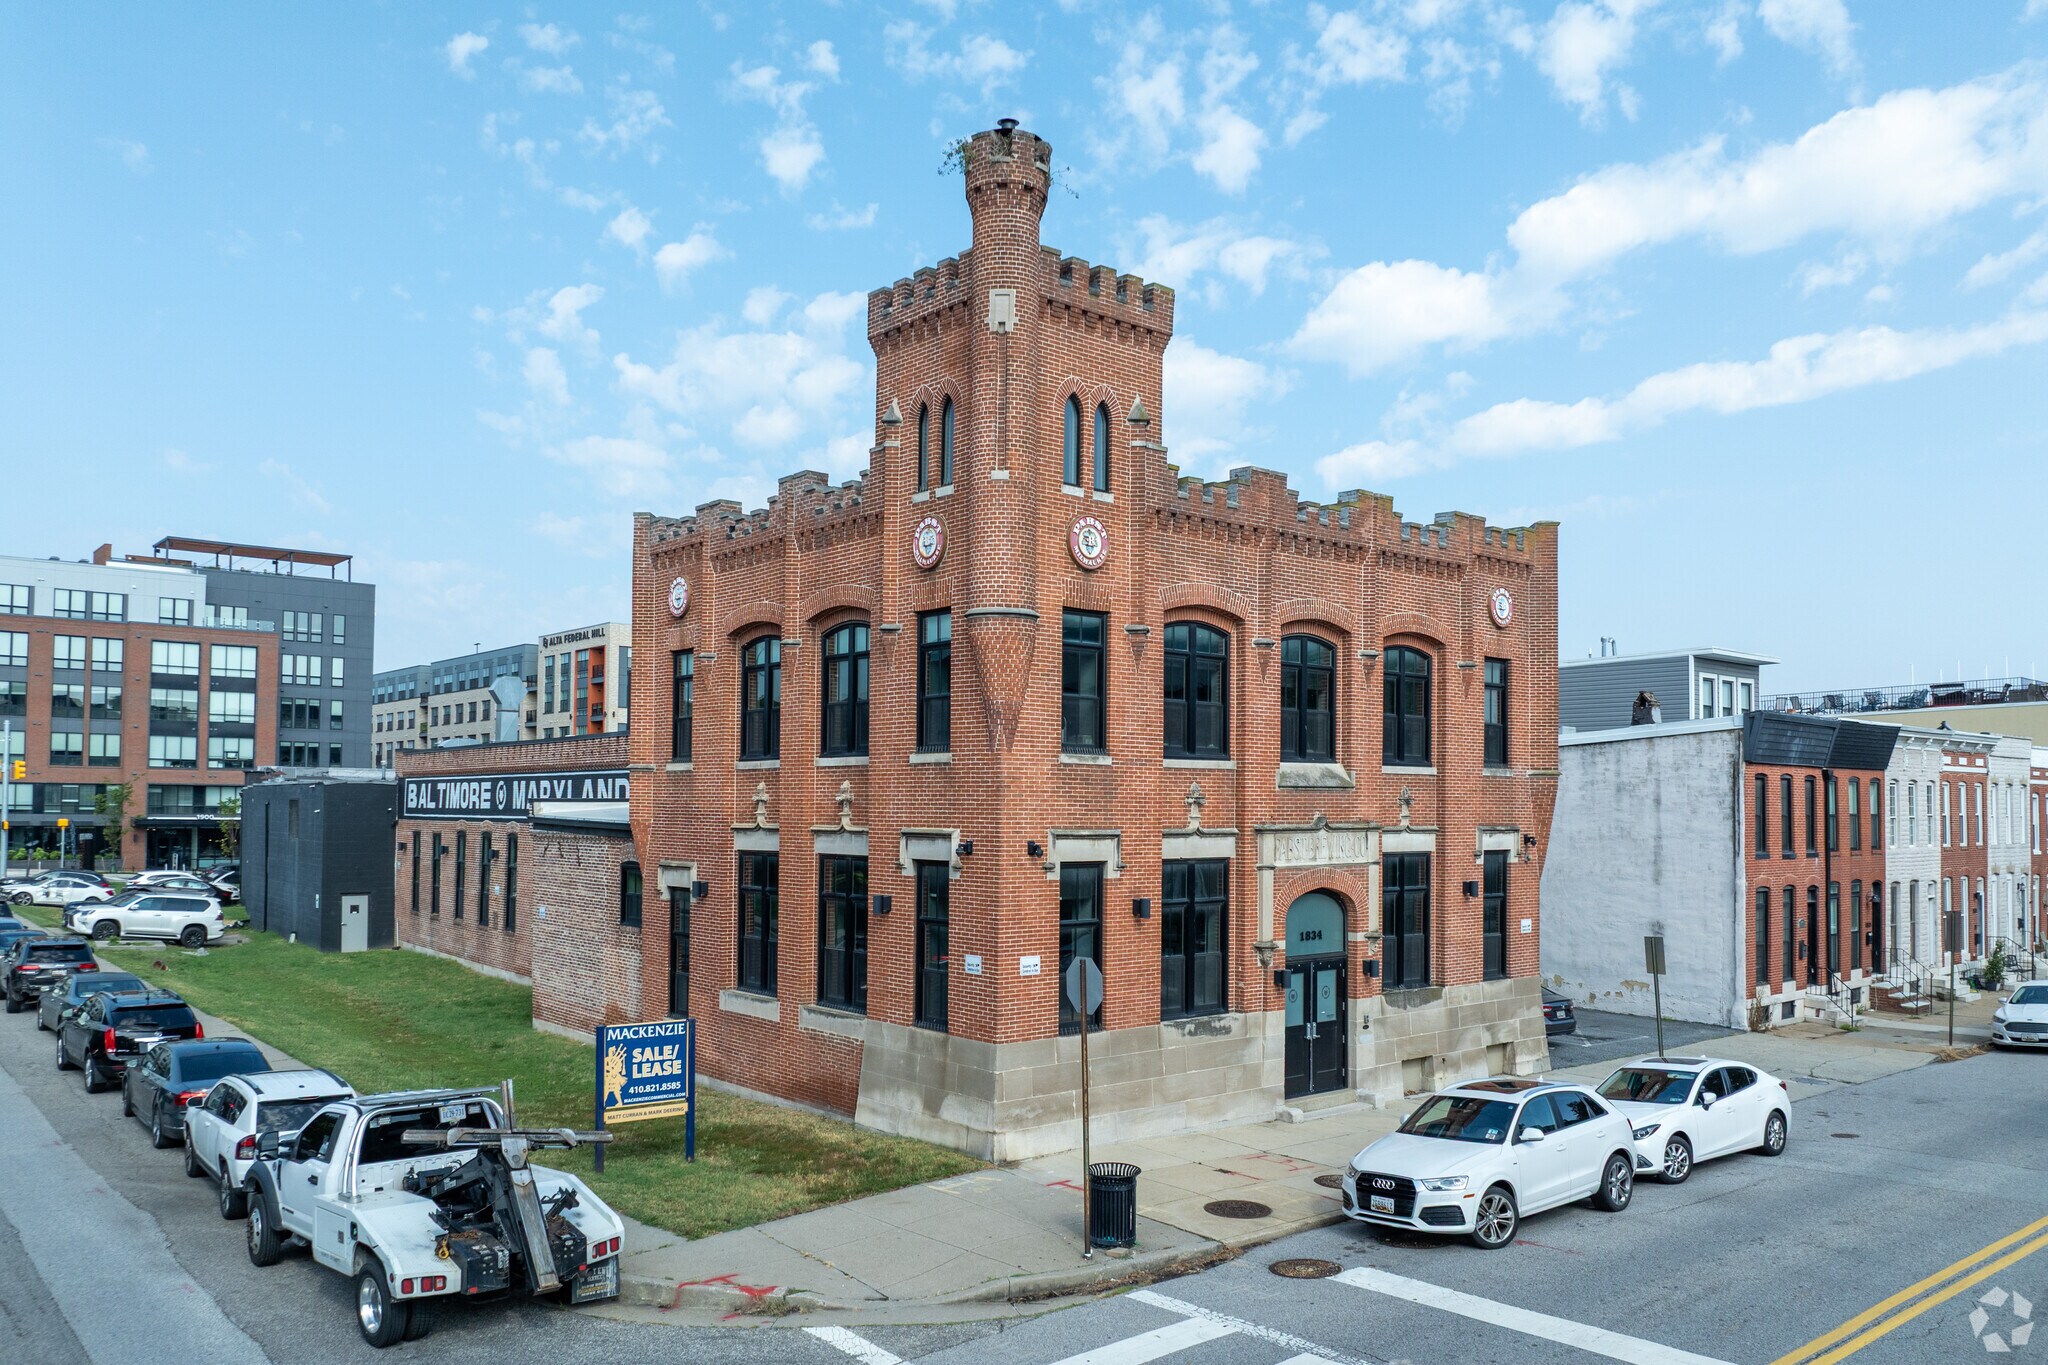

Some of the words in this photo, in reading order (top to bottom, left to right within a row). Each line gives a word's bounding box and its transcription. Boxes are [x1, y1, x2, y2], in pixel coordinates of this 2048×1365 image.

[914, 517, 942, 538] PABST
[1073, 516, 1108, 539] PABST
[1073, 545, 1107, 566] MILWAUKEE
[549, 636, 562, 646] ALTA
[564, 630, 590, 643] FEDERAL
[591, 628, 605, 638] HILL
[407, 780, 492, 809] BALTIMORE
[1299, 930, 1323, 942] 1834
[607, 1023, 686, 1041] MACKENZIE
[632, 1044, 680, 1063] SALE/
[632, 1059, 682, 1079] LEASE
[628, 1081, 681, 1095] 410.821.8585
[623, 1091, 686, 1104] MACKENZIECOMMERCIAL.COM
[663, 1106, 685, 1114] DEERING
